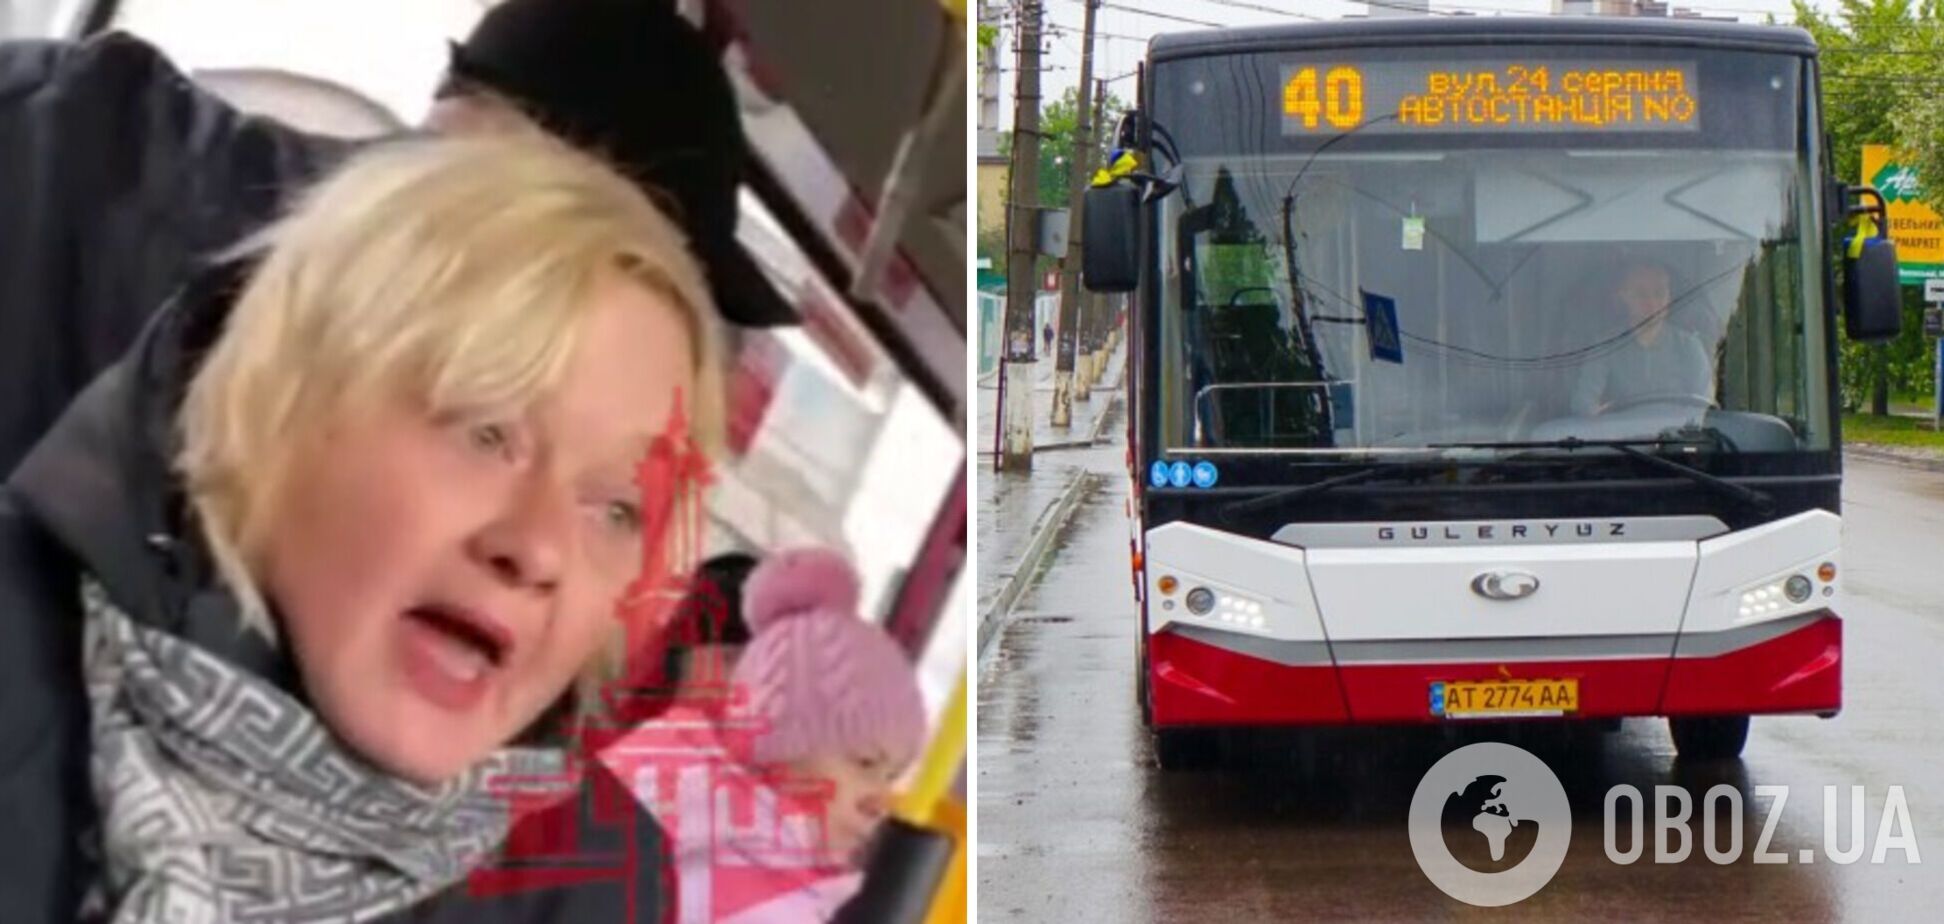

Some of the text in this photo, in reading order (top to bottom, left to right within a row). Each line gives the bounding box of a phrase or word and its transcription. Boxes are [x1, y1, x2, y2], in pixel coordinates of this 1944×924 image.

[1563, 70, 1683, 96] серпня
[1283, 66, 1363, 129] 40
[1400, 95, 1632, 124] АВТОСТАНЦІЯ
[1446, 684, 1571, 709] AT 2774 AA
